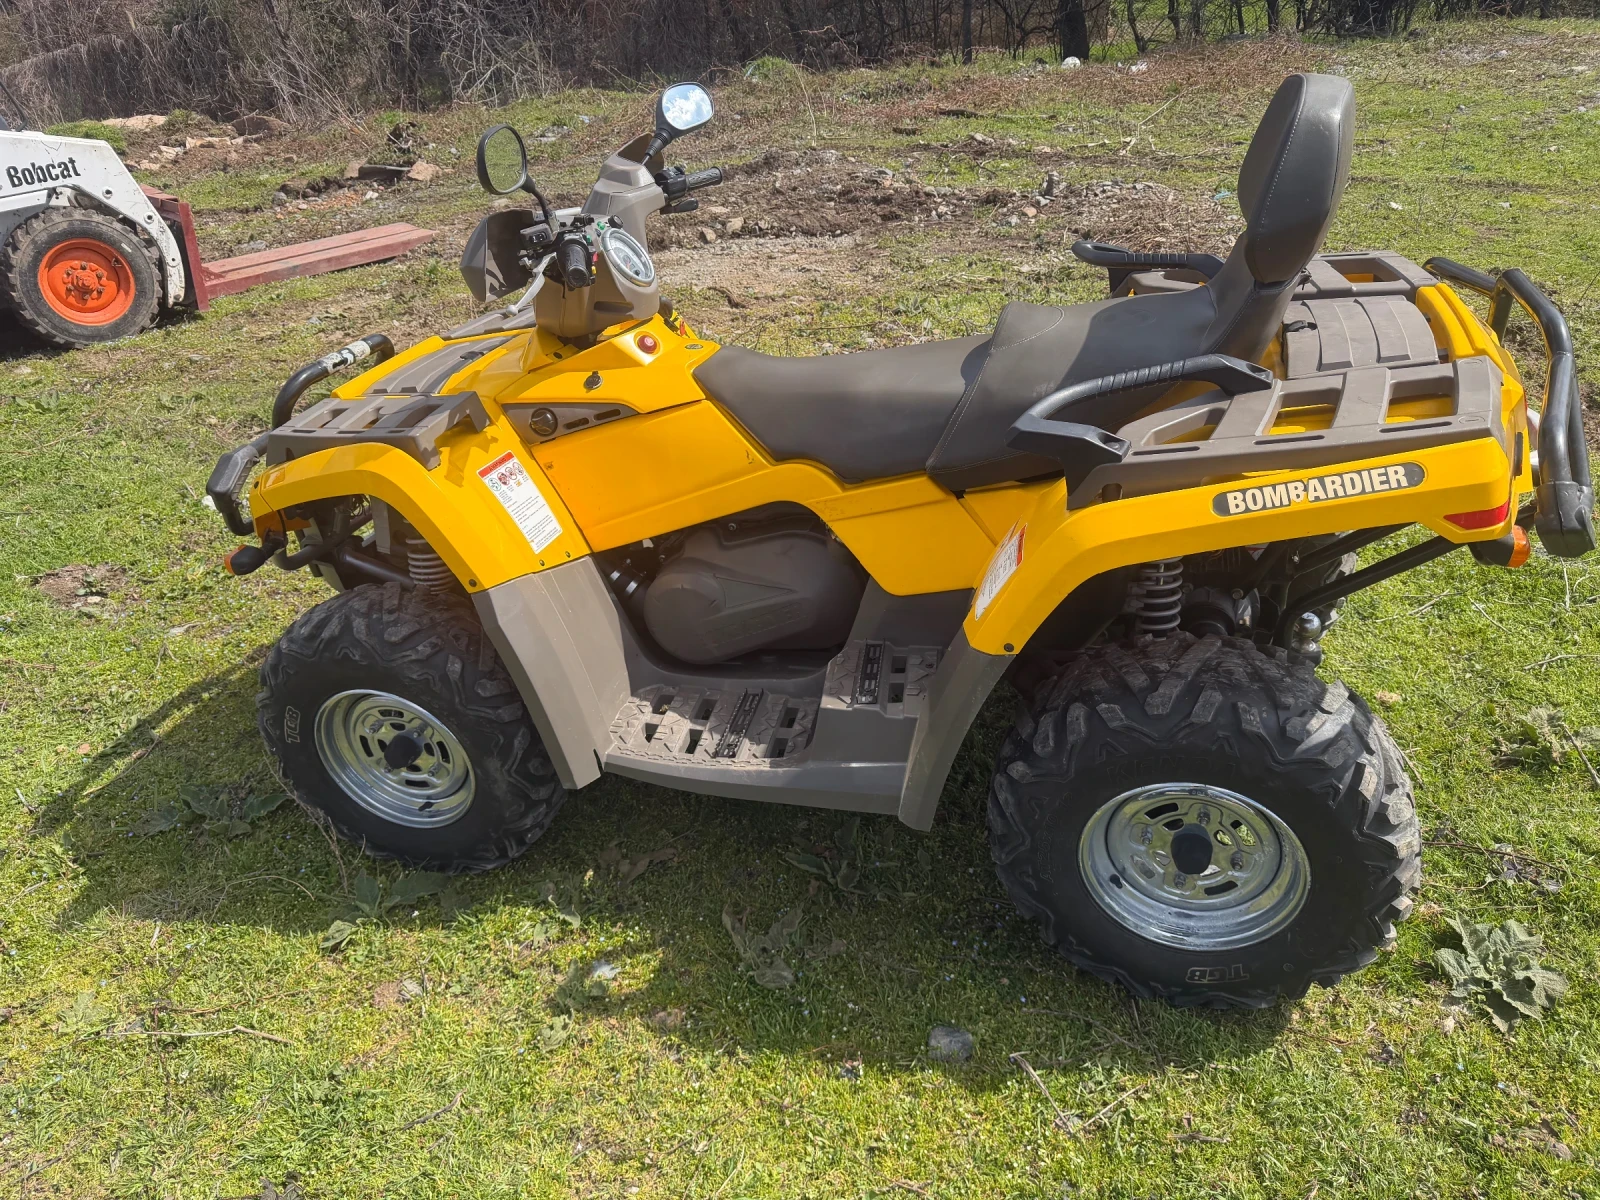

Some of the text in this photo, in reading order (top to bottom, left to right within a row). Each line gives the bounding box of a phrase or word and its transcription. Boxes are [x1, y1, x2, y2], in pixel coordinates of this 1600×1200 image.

[6, 157, 81, 188] Bobcat
[1226, 465, 1409, 514] BOMBARDIER
[284, 705, 301, 744] TGB
[1185, 963, 1250, 984] TGB
